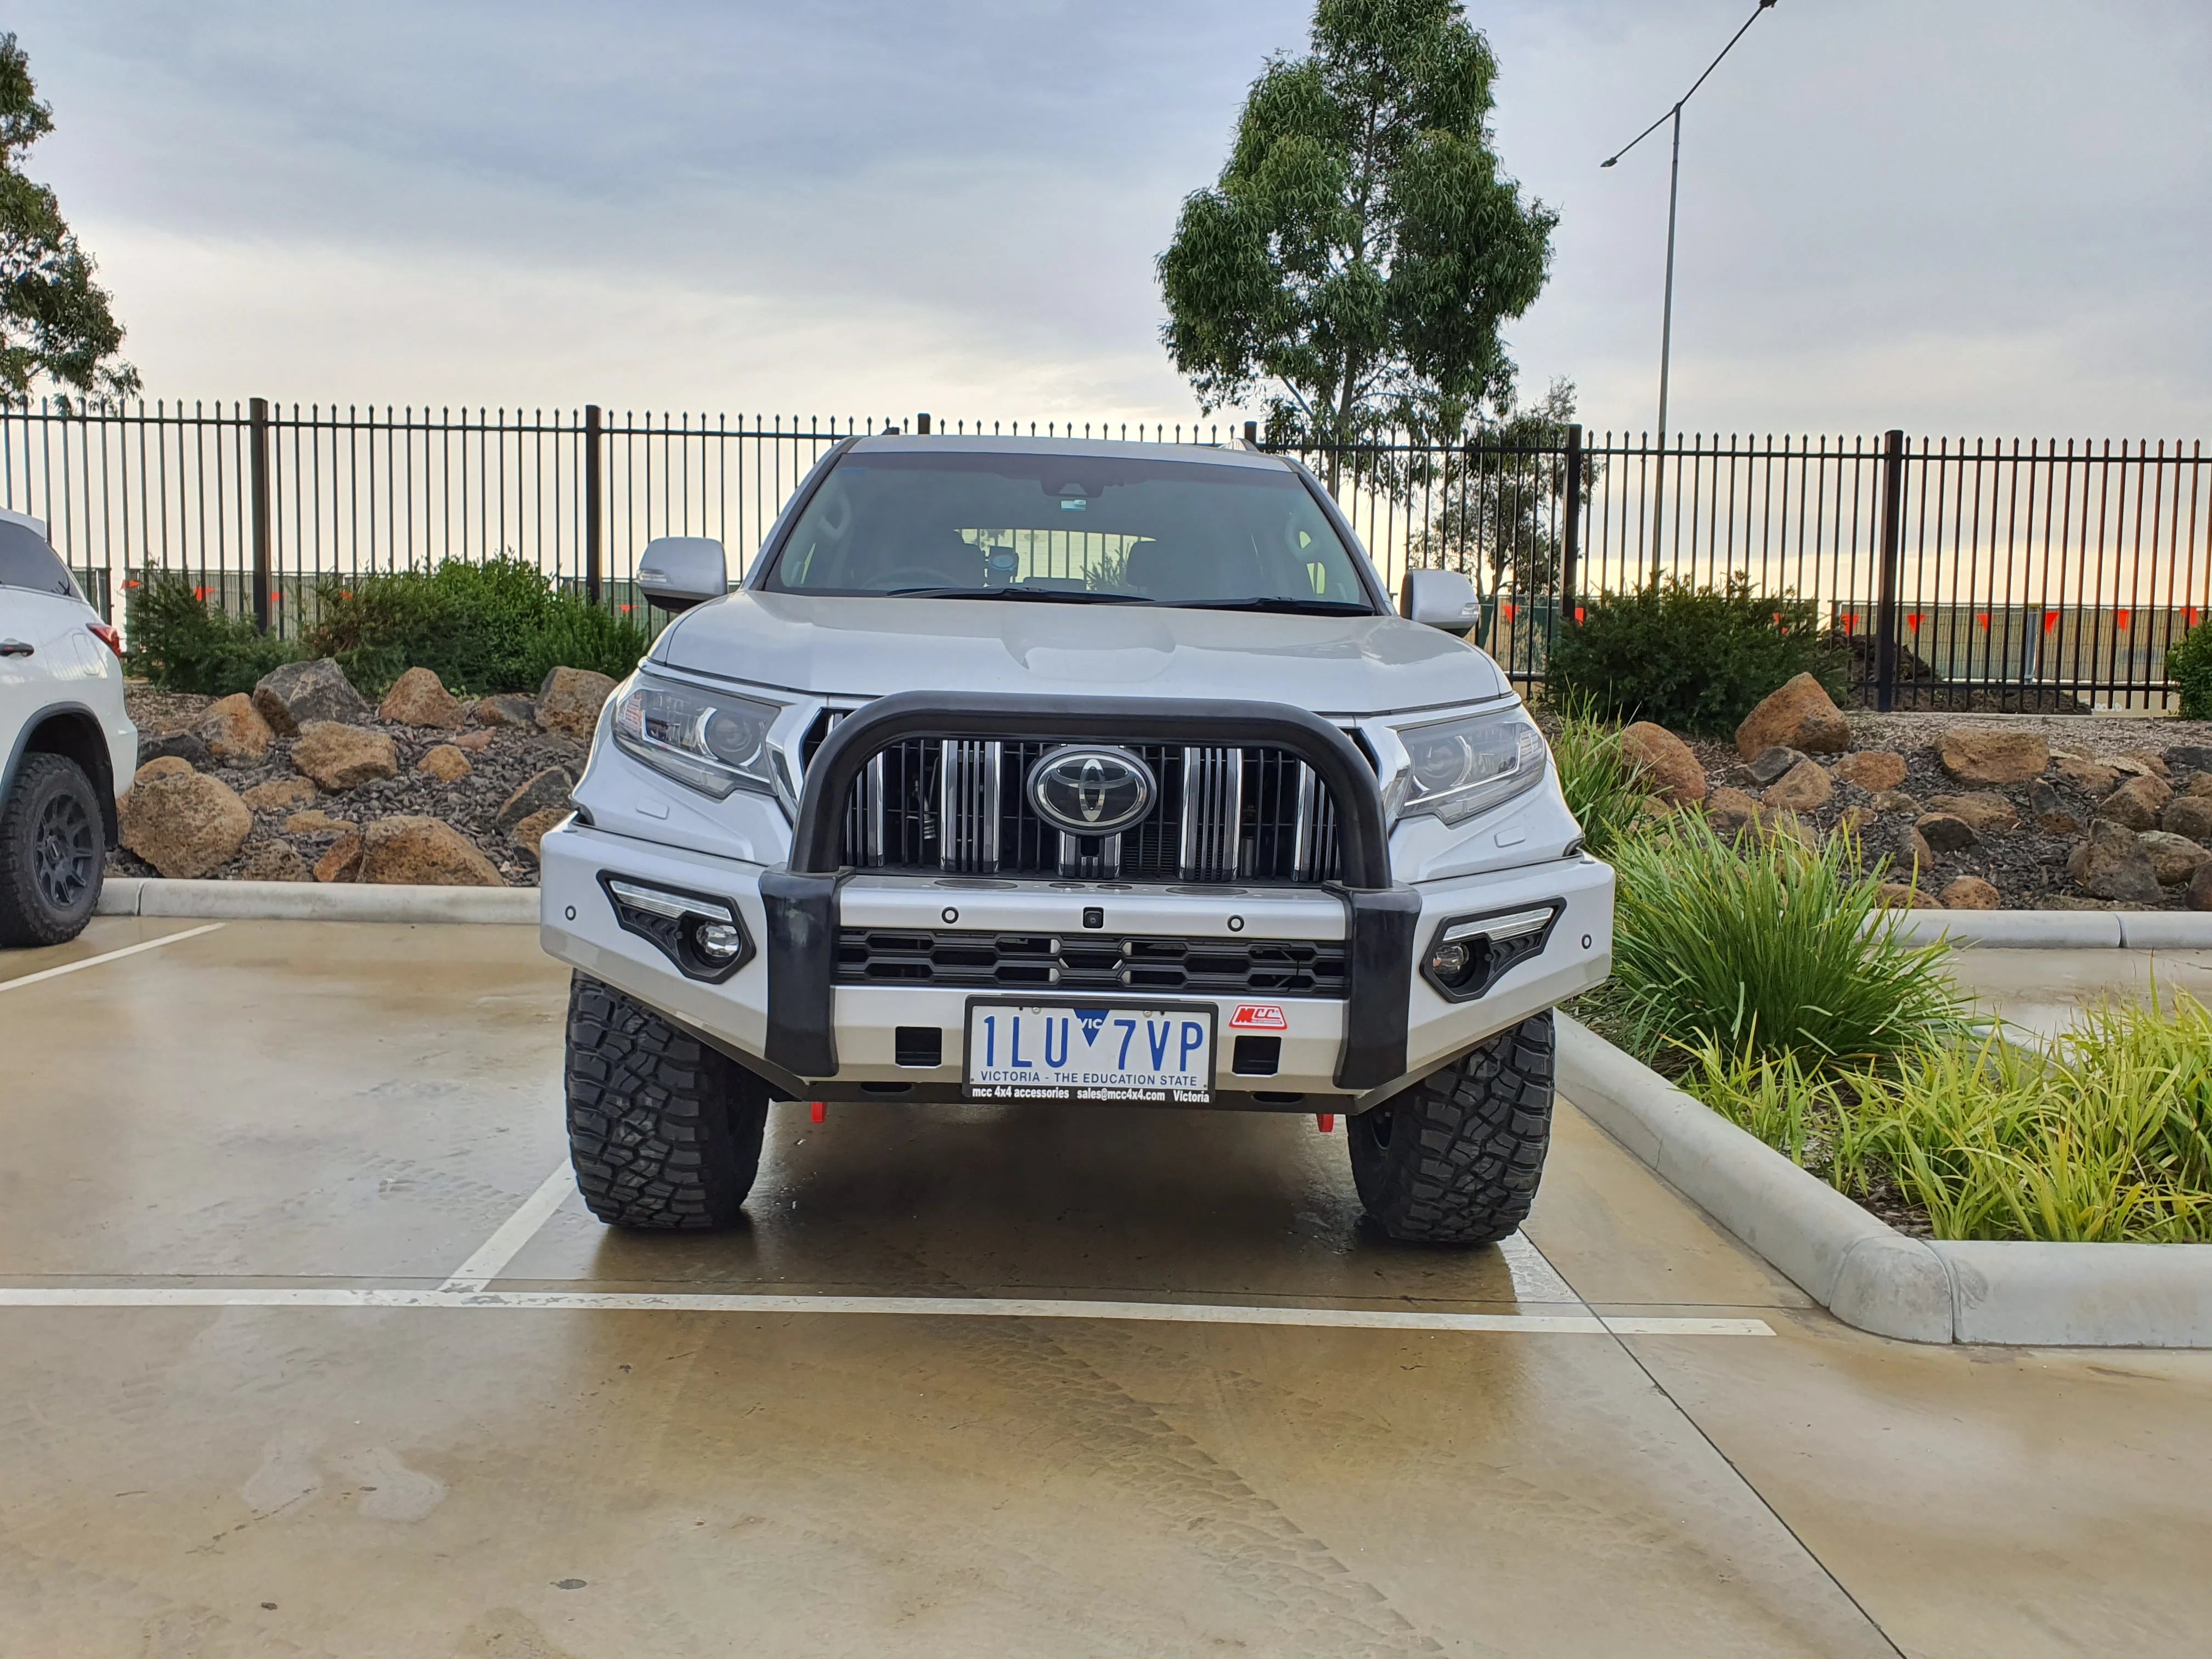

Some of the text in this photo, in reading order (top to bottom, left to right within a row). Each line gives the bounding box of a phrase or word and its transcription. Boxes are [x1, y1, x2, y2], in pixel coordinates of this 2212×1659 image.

[1077, 1018, 1103, 1029] VIC
[984, 1015, 1203, 1071] 1LU 7VP
[980, 1070, 1040, 1082] VICTORIA
[1054, 1072, 1078, 1082] THE
[1083, 1073, 1155, 1085] EDUCATION
[1160, 1075, 1197, 1086] STATE
[972, 1085, 1210, 1103] mcc 4x4 accessories sales@mcc4x4.com Victoria
